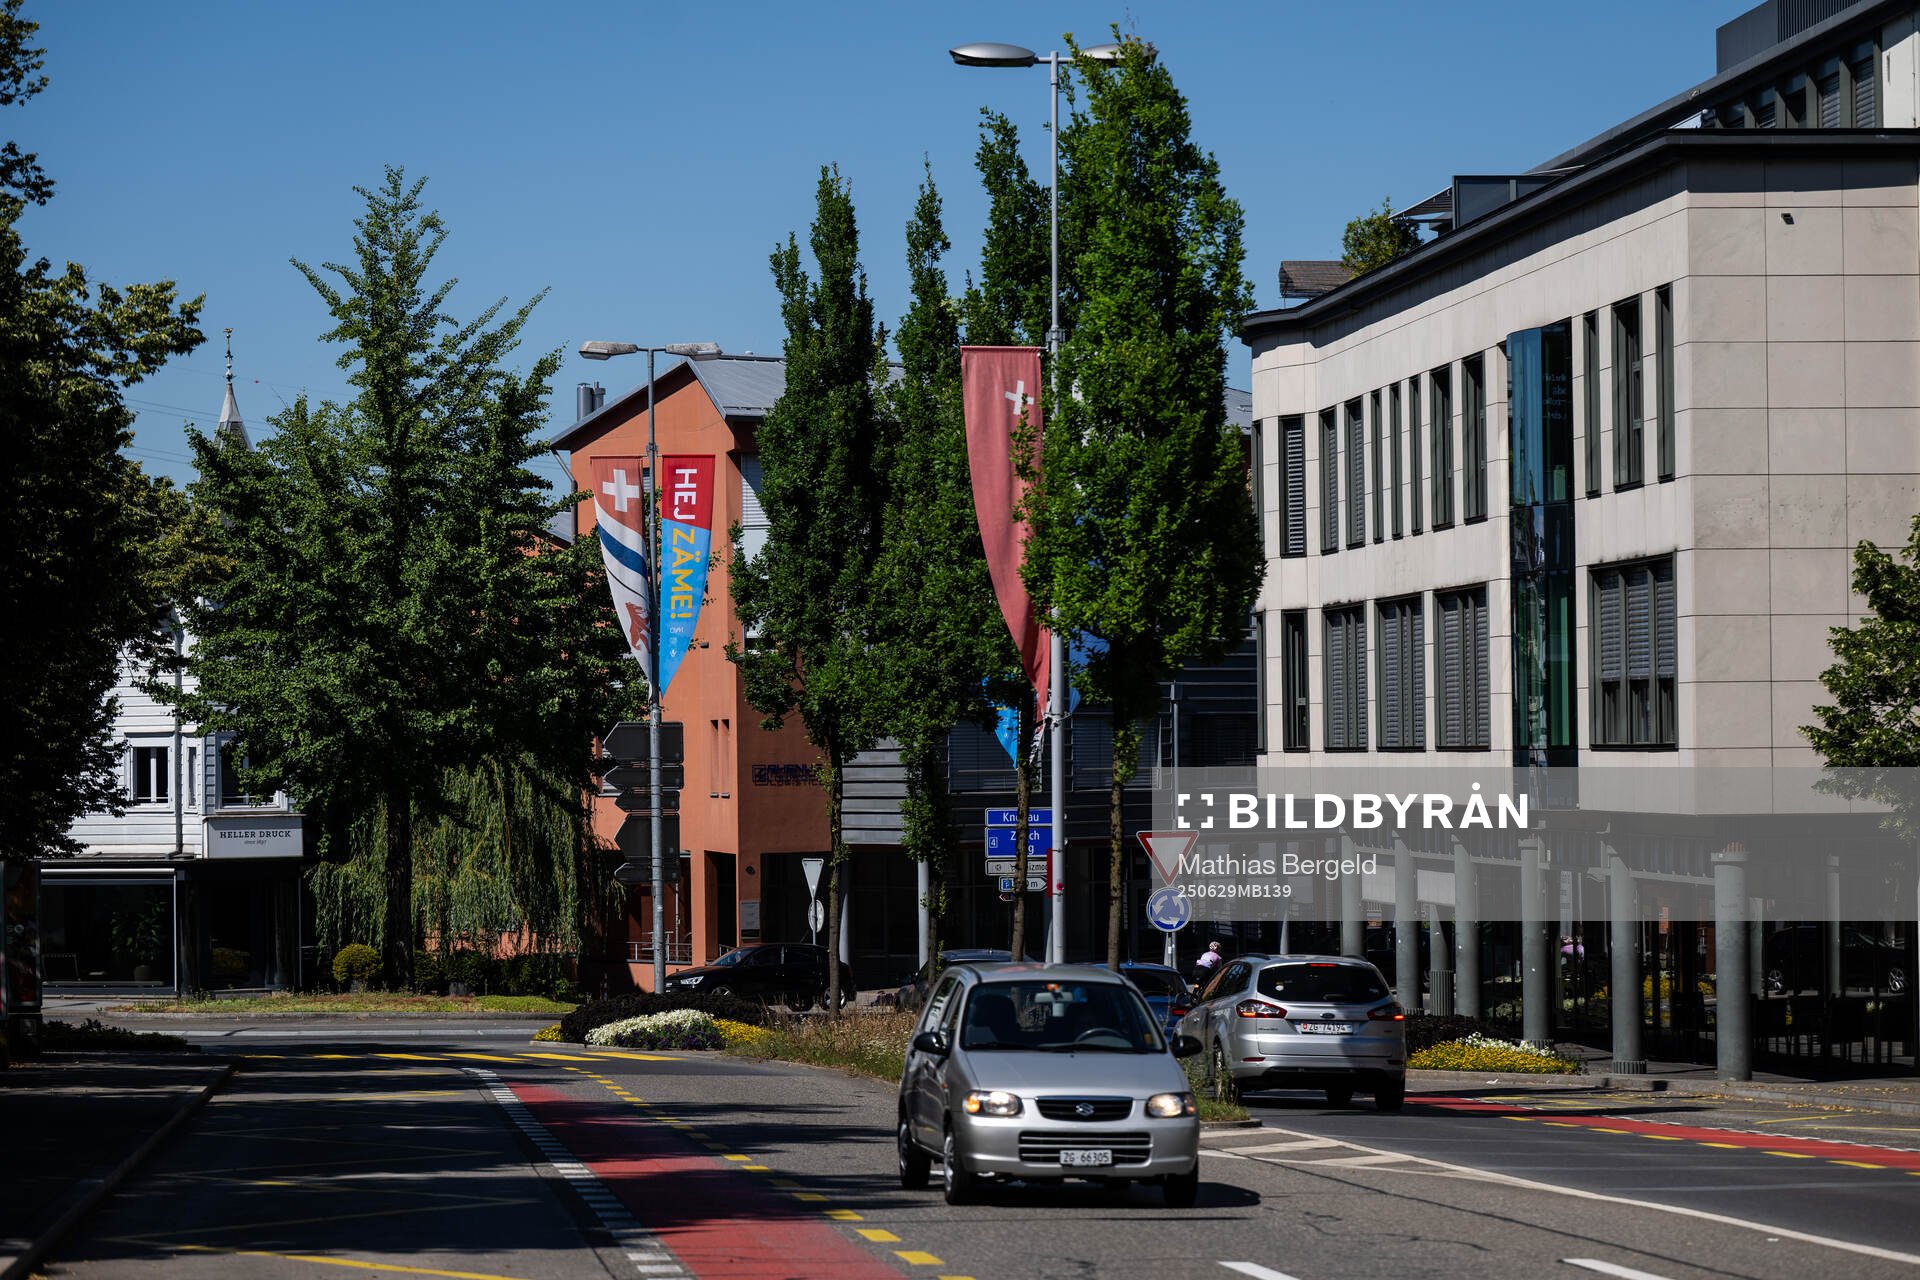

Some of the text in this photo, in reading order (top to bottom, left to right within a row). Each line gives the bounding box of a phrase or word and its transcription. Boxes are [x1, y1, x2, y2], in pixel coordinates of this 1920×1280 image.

[673, 469, 697, 520] HEJ
[670, 528, 701, 619] ZÄME!
[1002, 812, 1040, 822] Knau
[220, 830, 292, 839] HELLER DRUCK
[1010, 830, 1040, 841] Zch
[1063, 1152, 1075, 1162] ZG
